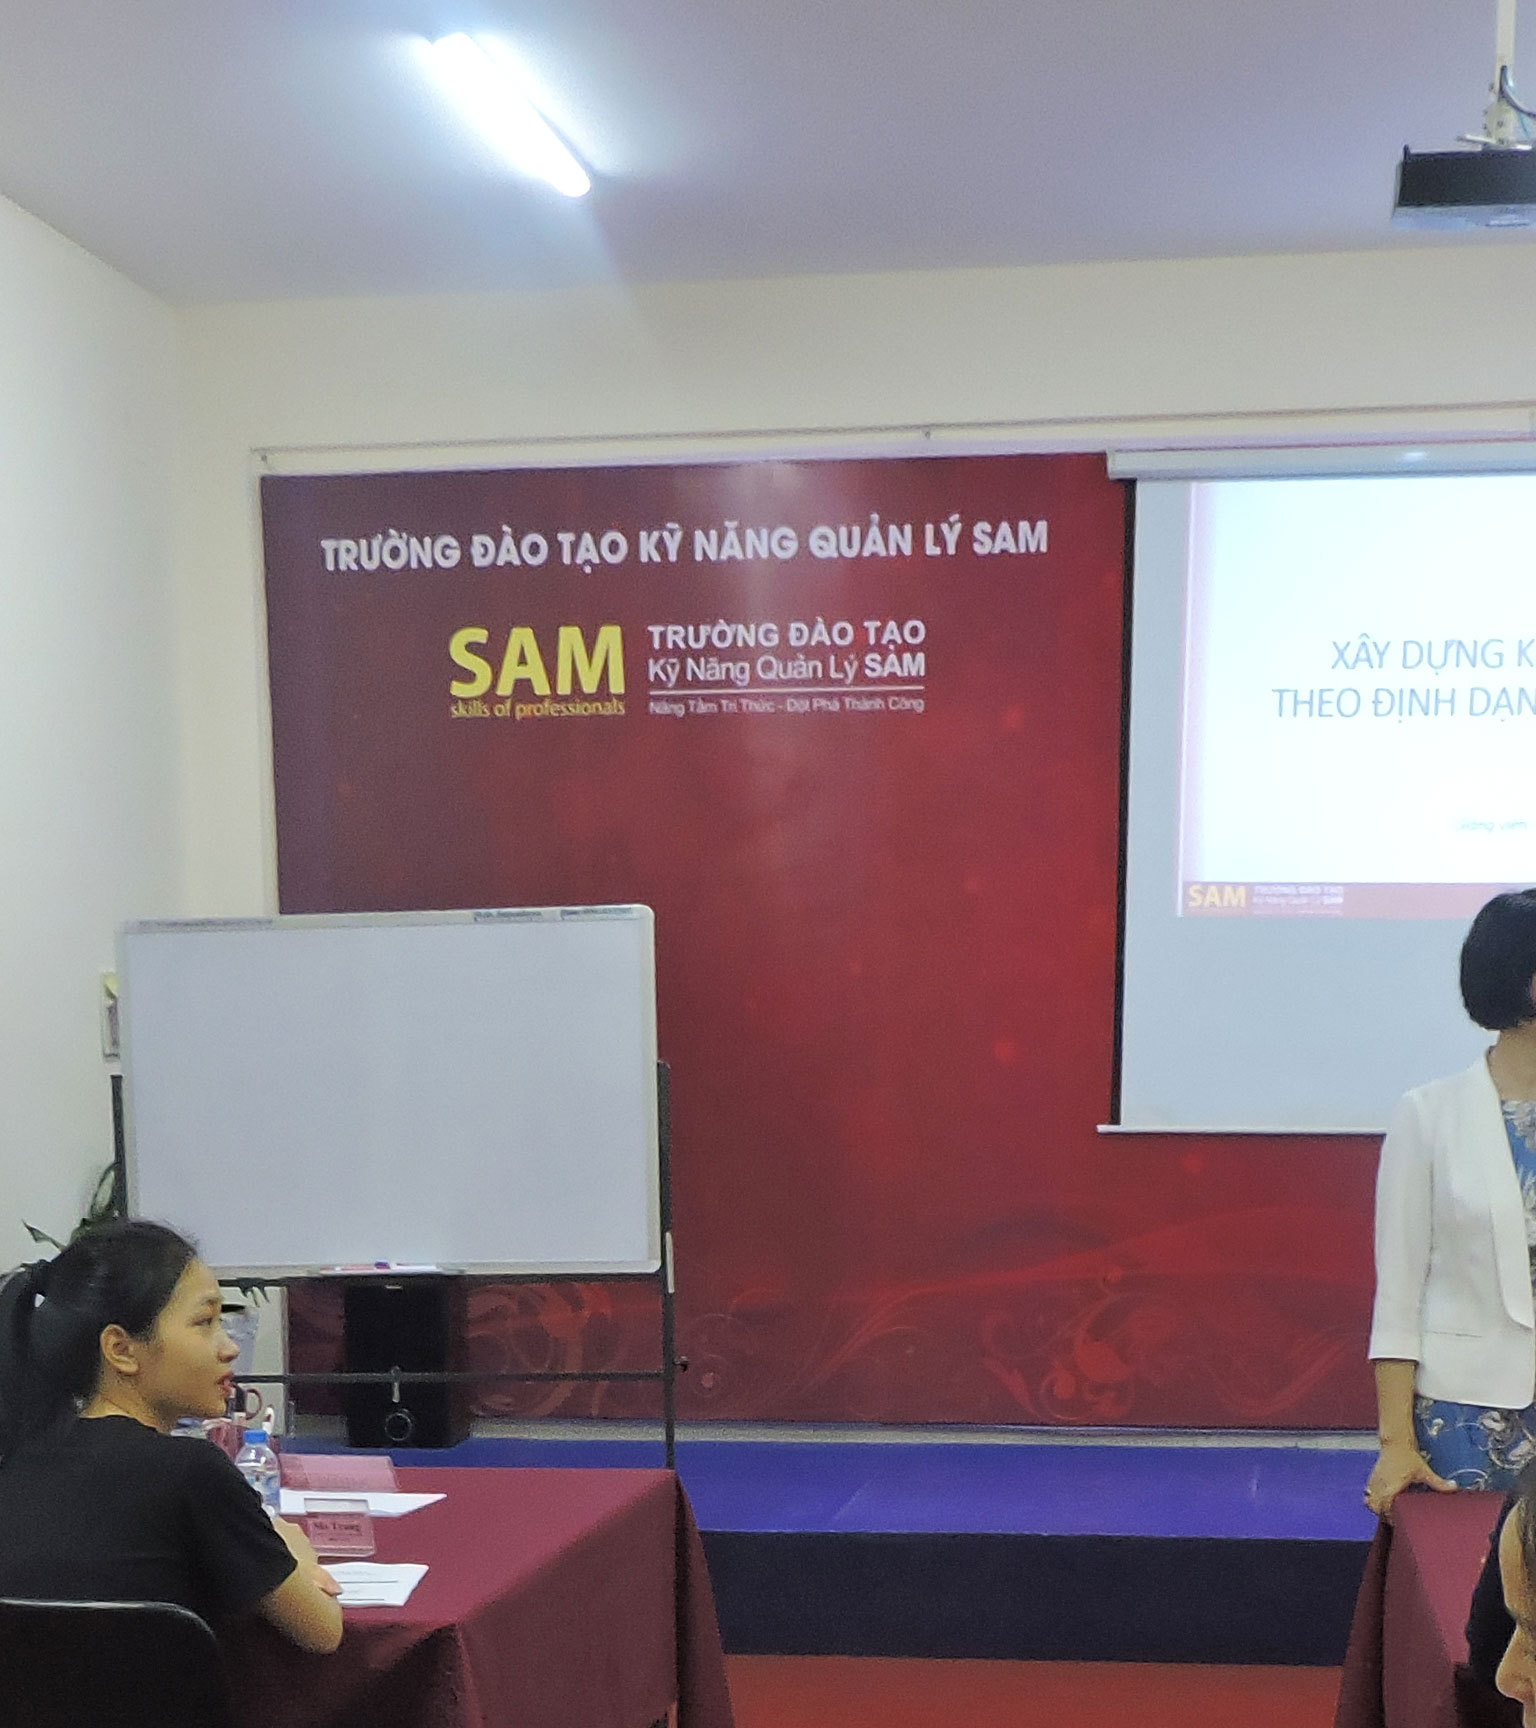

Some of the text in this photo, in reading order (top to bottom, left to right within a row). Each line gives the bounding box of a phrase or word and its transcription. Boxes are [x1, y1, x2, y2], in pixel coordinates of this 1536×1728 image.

[321, 512, 1048, 574] TRƯỜNG ĐÀO TẠO KỸ NĂNG QUẢN LÝ SAM
[648, 615, 926, 650] TRƯỜNG ĐÀO TẠO
[450, 624, 626, 698] SAM
[649, 656, 680, 688] Kỹ
[685, 656, 750, 686] Năng
[755, 652, 823, 681] Quản
[864, 651, 926, 678] SAM
[1331, 632, 1391, 670] XÂY
[1401, 638, 1505, 676] DỰNG
[451, 699, 490, 718] skills
[515, 698, 626, 721] professionals
[1271, 688, 1362, 718] THEO
[1371, 687, 1456, 724] ĐỊNH
[1188, 883, 1248, 909] SAM
